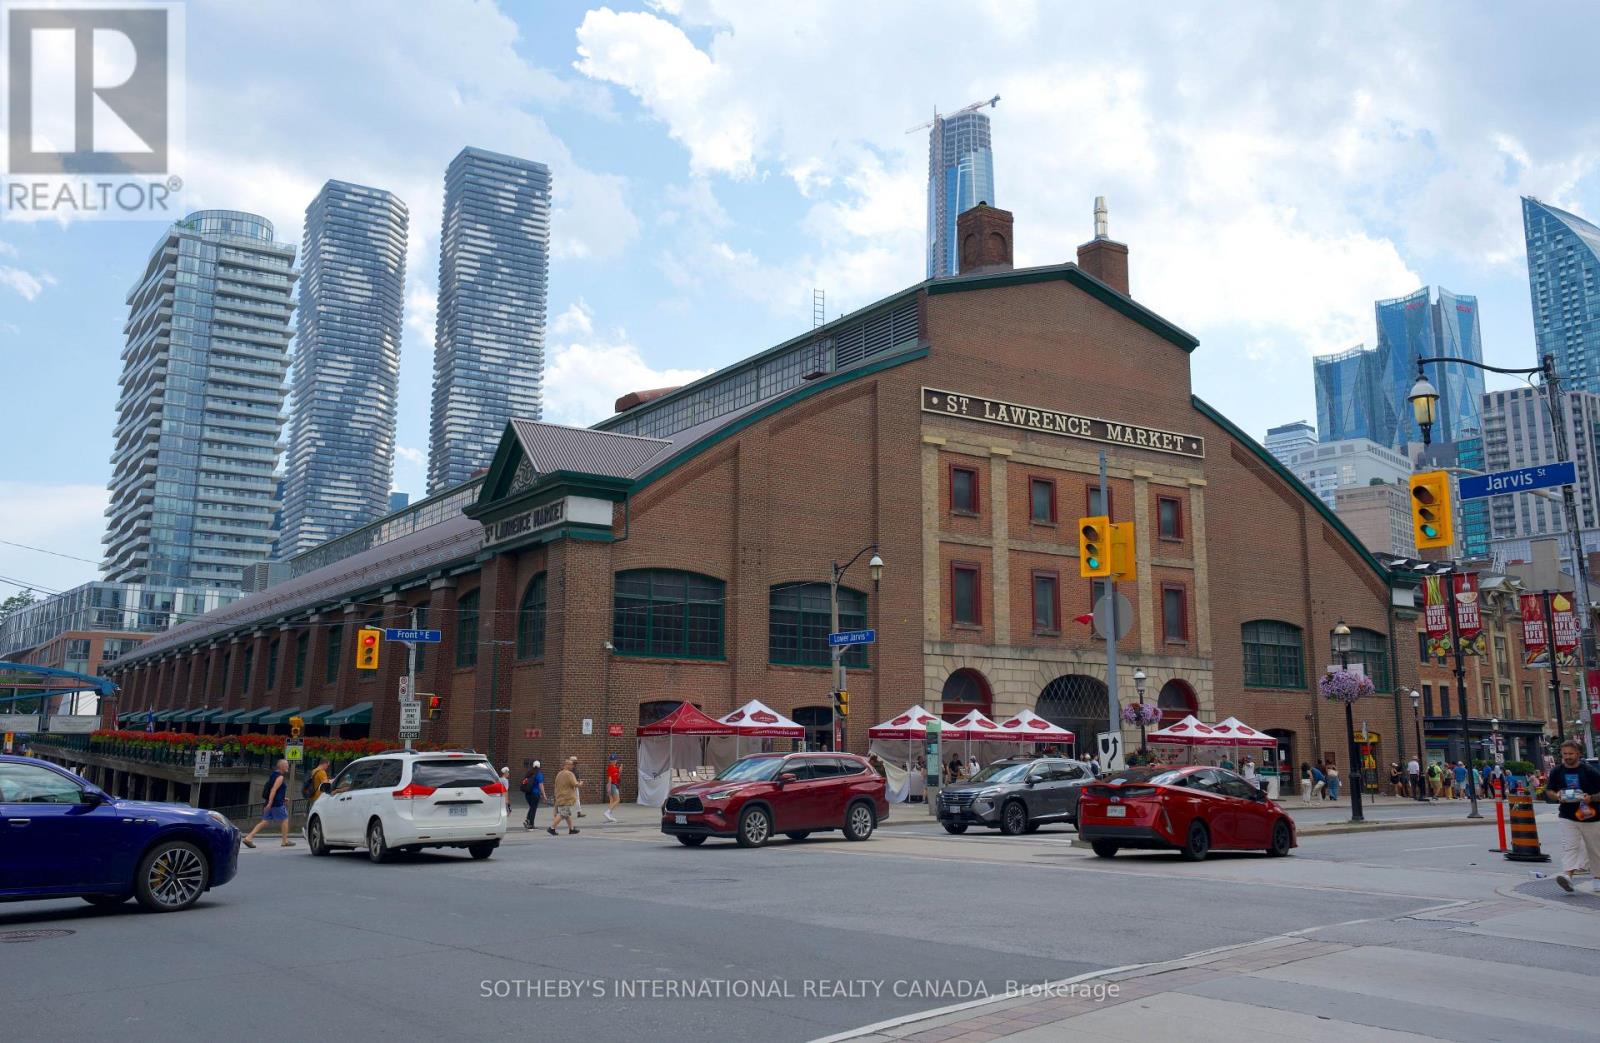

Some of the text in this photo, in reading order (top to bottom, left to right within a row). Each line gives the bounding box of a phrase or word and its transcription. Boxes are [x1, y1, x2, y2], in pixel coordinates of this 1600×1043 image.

[984, 401, 1092, 436] LAWRENCE
[1106, 423, 1184, 451] MARKET
[1486, 468, 1546, 491] Jarvis St
[533, 500, 565, 528] MARKET
[1427, 616, 1446, 625] OPEN
[1459, 613, 1478, 623] OPEN
[1555, 622, 1574, 630] OPEN
[397, 630, 418, 639] Front
[425, 631, 430, 639] E
[850, 633, 866, 642] Jarvis
[1525, 631, 1543, 639] OPEN
